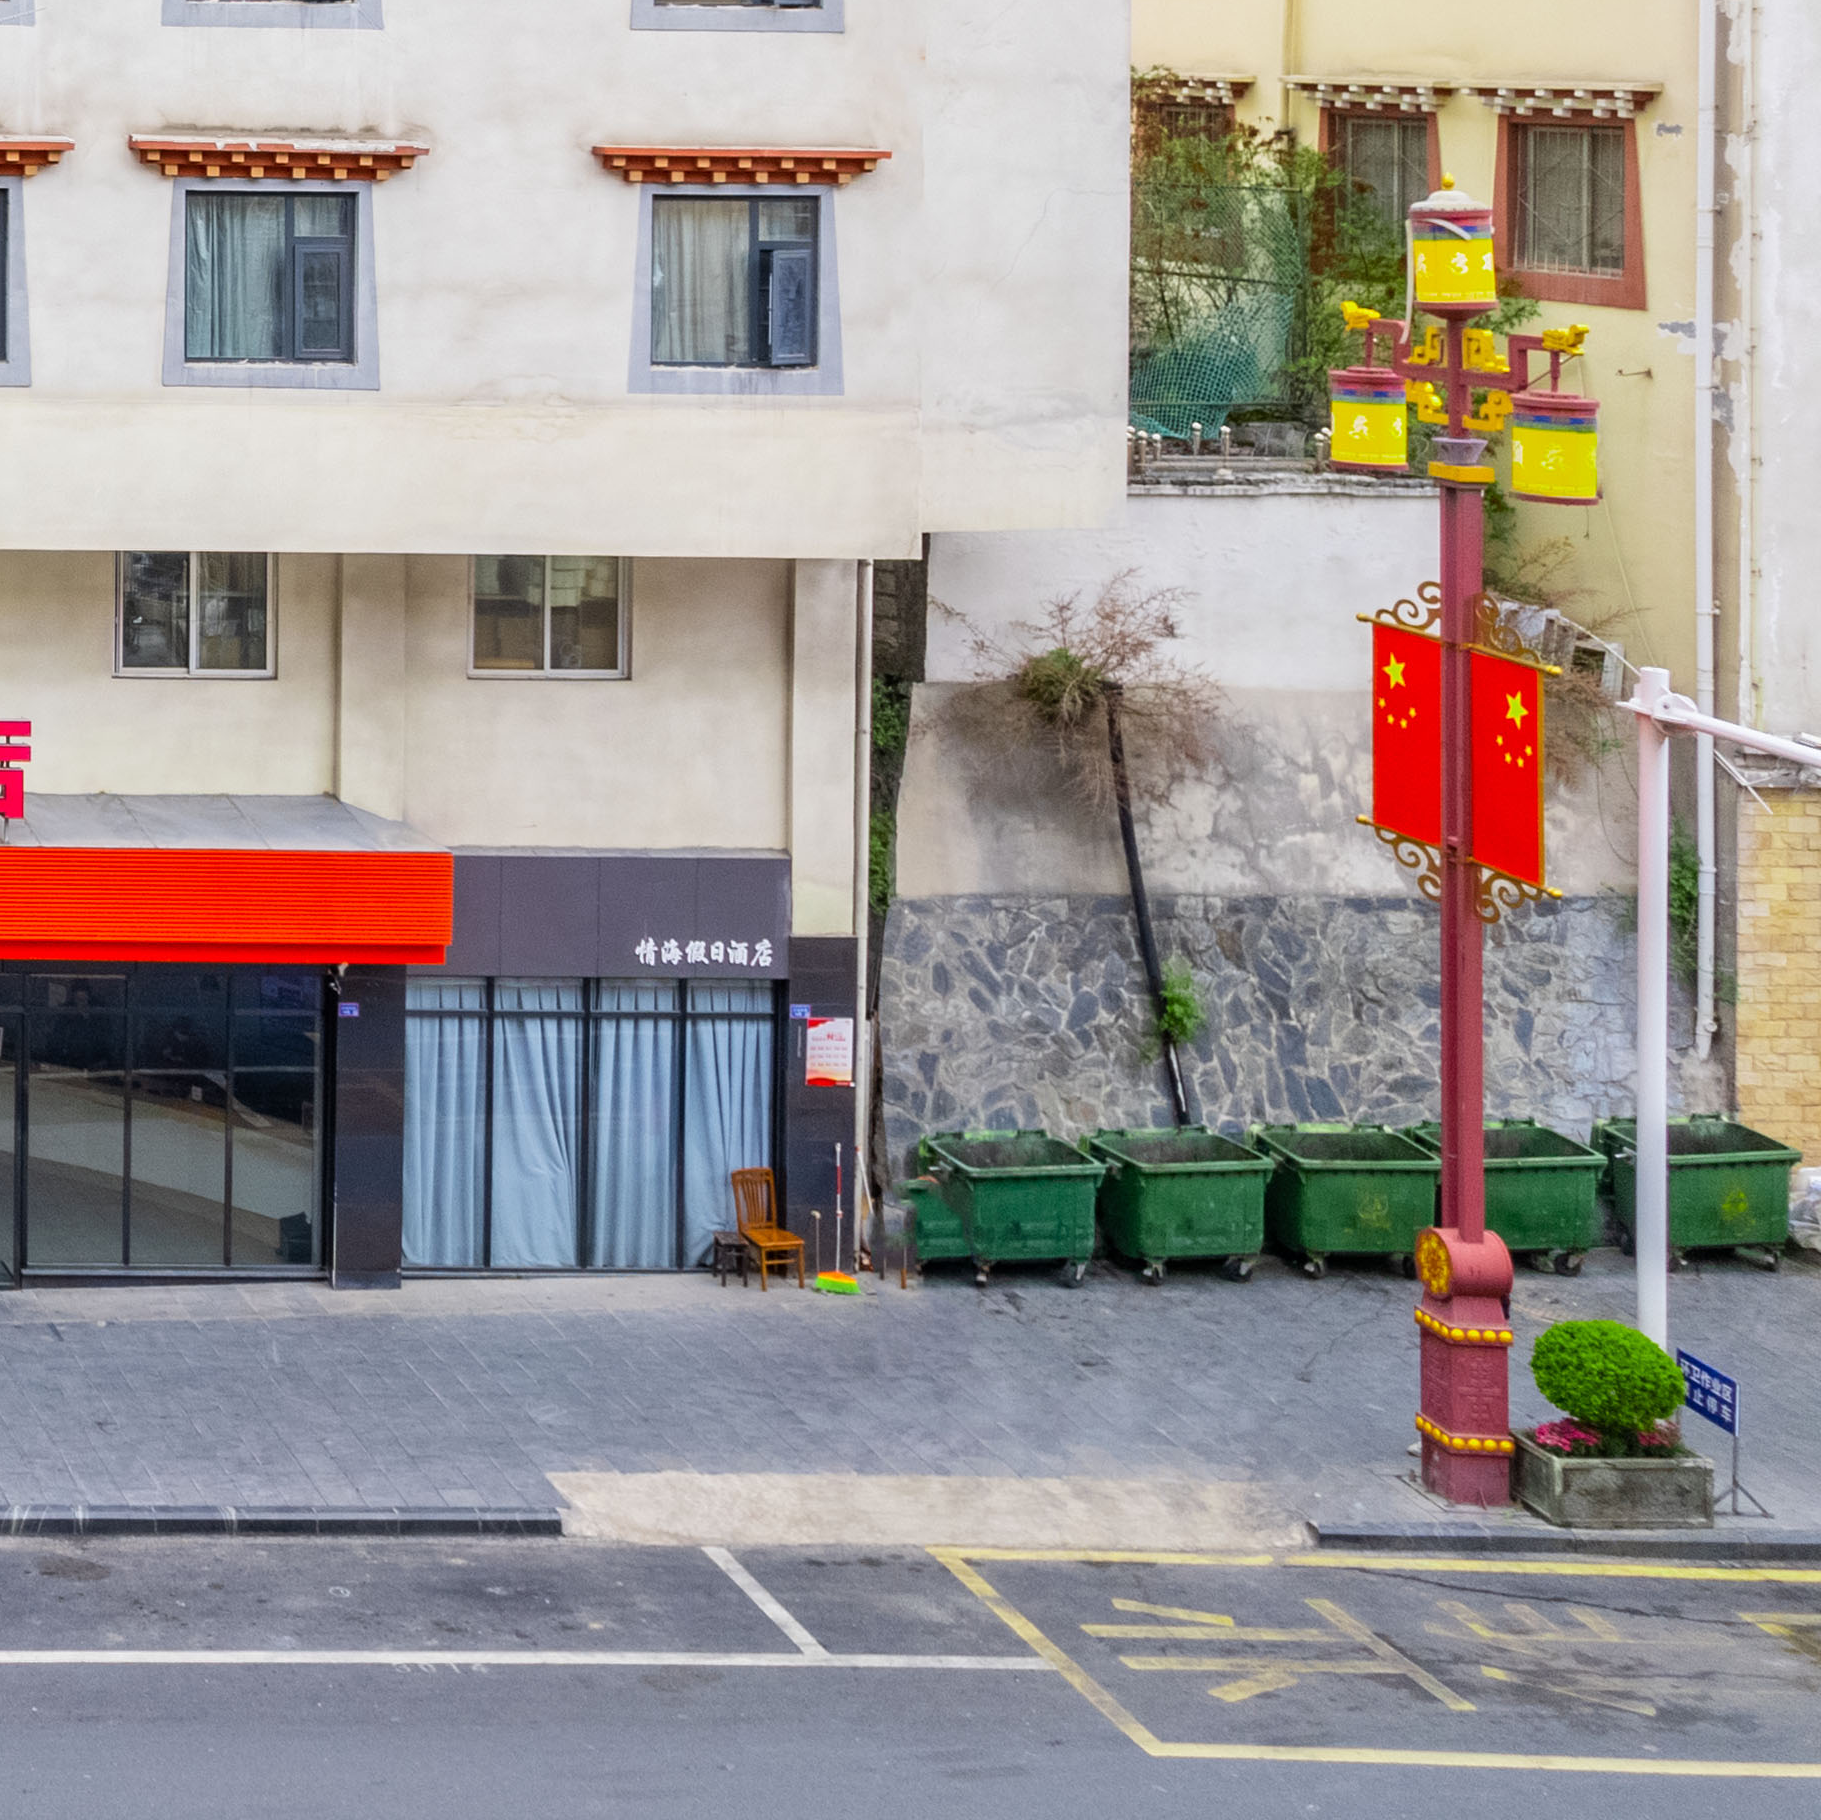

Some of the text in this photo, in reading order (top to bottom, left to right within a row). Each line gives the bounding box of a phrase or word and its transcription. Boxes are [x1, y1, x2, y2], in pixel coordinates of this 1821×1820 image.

[635, 936, 774, 967] 情海假日酒店
